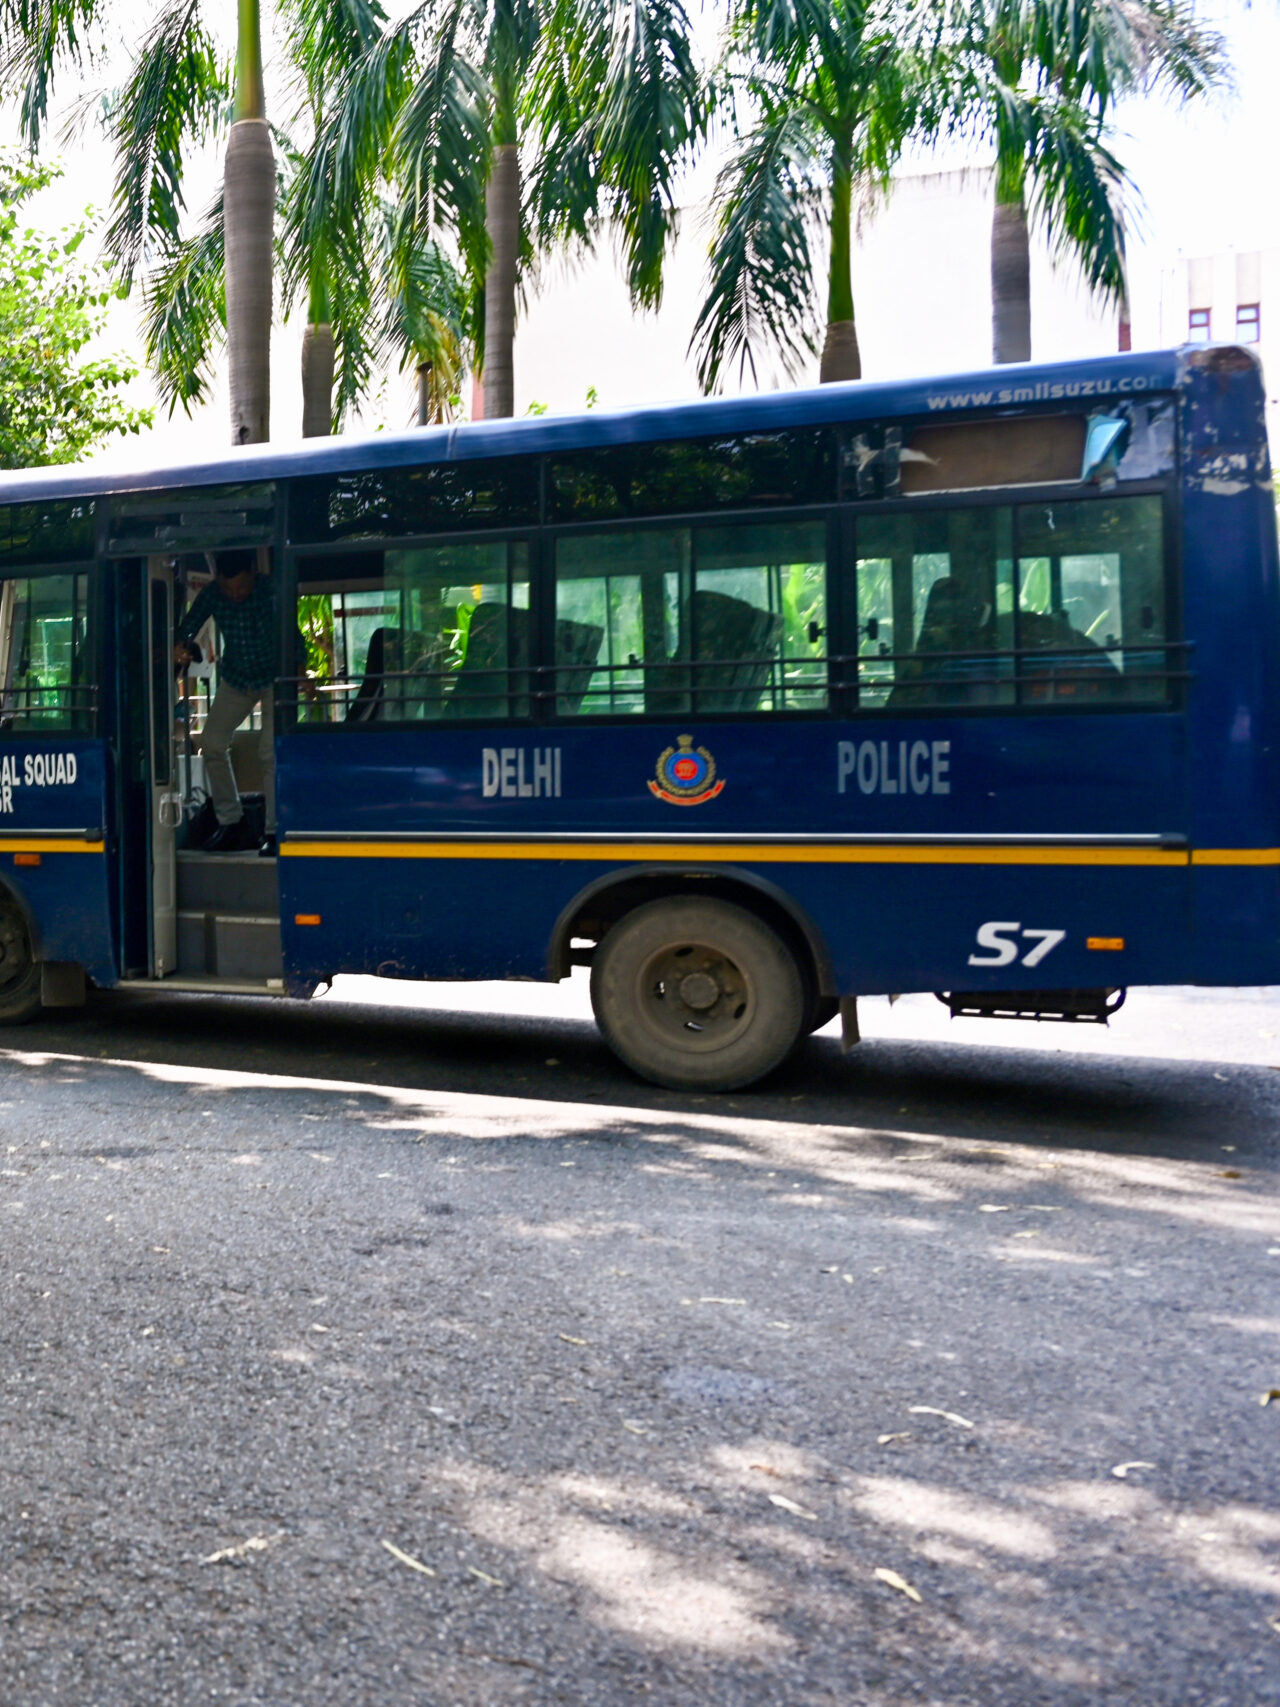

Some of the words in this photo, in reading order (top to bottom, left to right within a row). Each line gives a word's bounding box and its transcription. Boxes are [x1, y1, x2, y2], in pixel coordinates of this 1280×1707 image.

[24, 753, 77, 787] SQUAD
[483, 748, 562, 797] DELHI
[837, 741, 951, 794] POLICE
[967, 921, 1066, 967] S7
